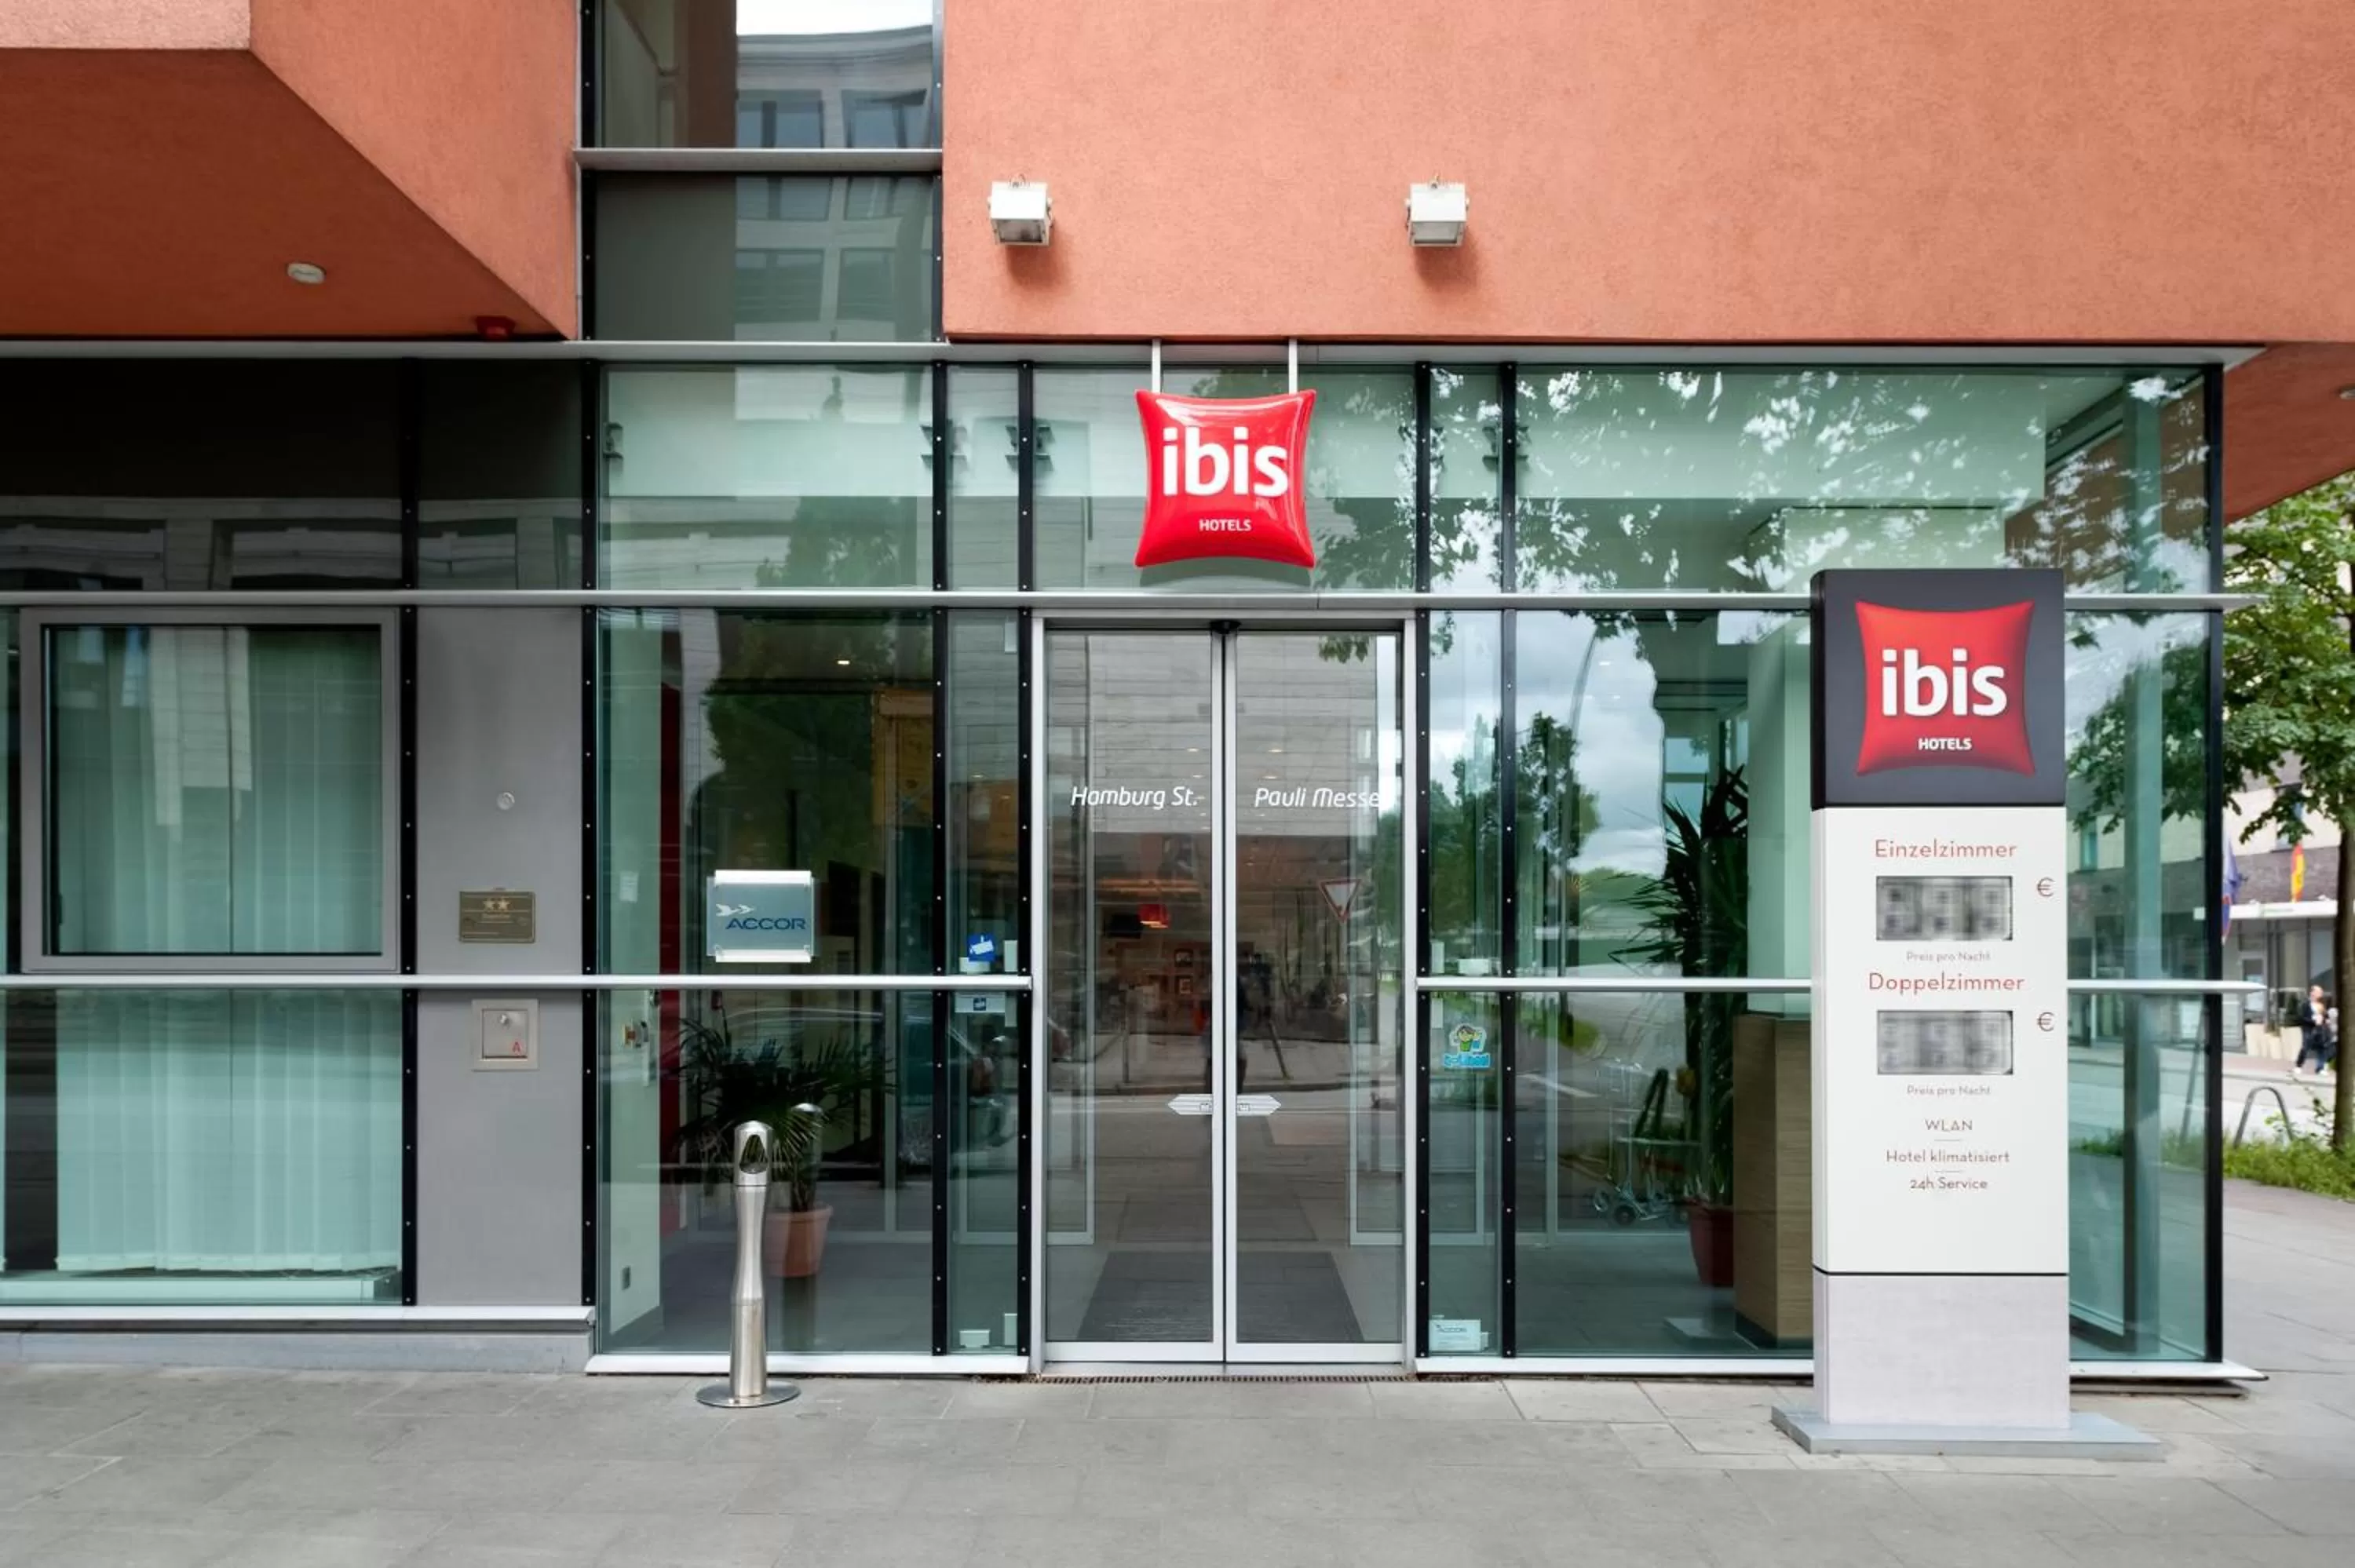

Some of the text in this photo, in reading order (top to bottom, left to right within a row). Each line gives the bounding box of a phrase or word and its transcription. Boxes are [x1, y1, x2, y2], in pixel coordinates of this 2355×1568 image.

[1163, 426, 1289, 497] ibis
[1199, 519, 1252, 531] HOTELS
[1882, 647, 2007, 717] ibis
[1918, 738, 1973, 750] HOTELS
[1071, 786, 1198, 810] Hamburg St.
[1254, 786, 1380, 808] Pauli Messe
[1875, 838, 2017, 858] Einzelzimmer
[2036, 877, 2055, 897] €
[725, 917, 806, 930] ACCOR
[1906, 950, 1991, 964] Preis pro Nacht
[1868, 971, 2025, 996] Doppelzimmer
[2036, 1012, 2055, 1032] €
[1907, 1085, 1991, 1097] Preis pro Nacht
[1925, 1119, 1973, 1131] WLAN
[1886, 1149, 2010, 1163] Hotel klimatisiert
[1910, 1174, 1988, 1190] 24h Service
